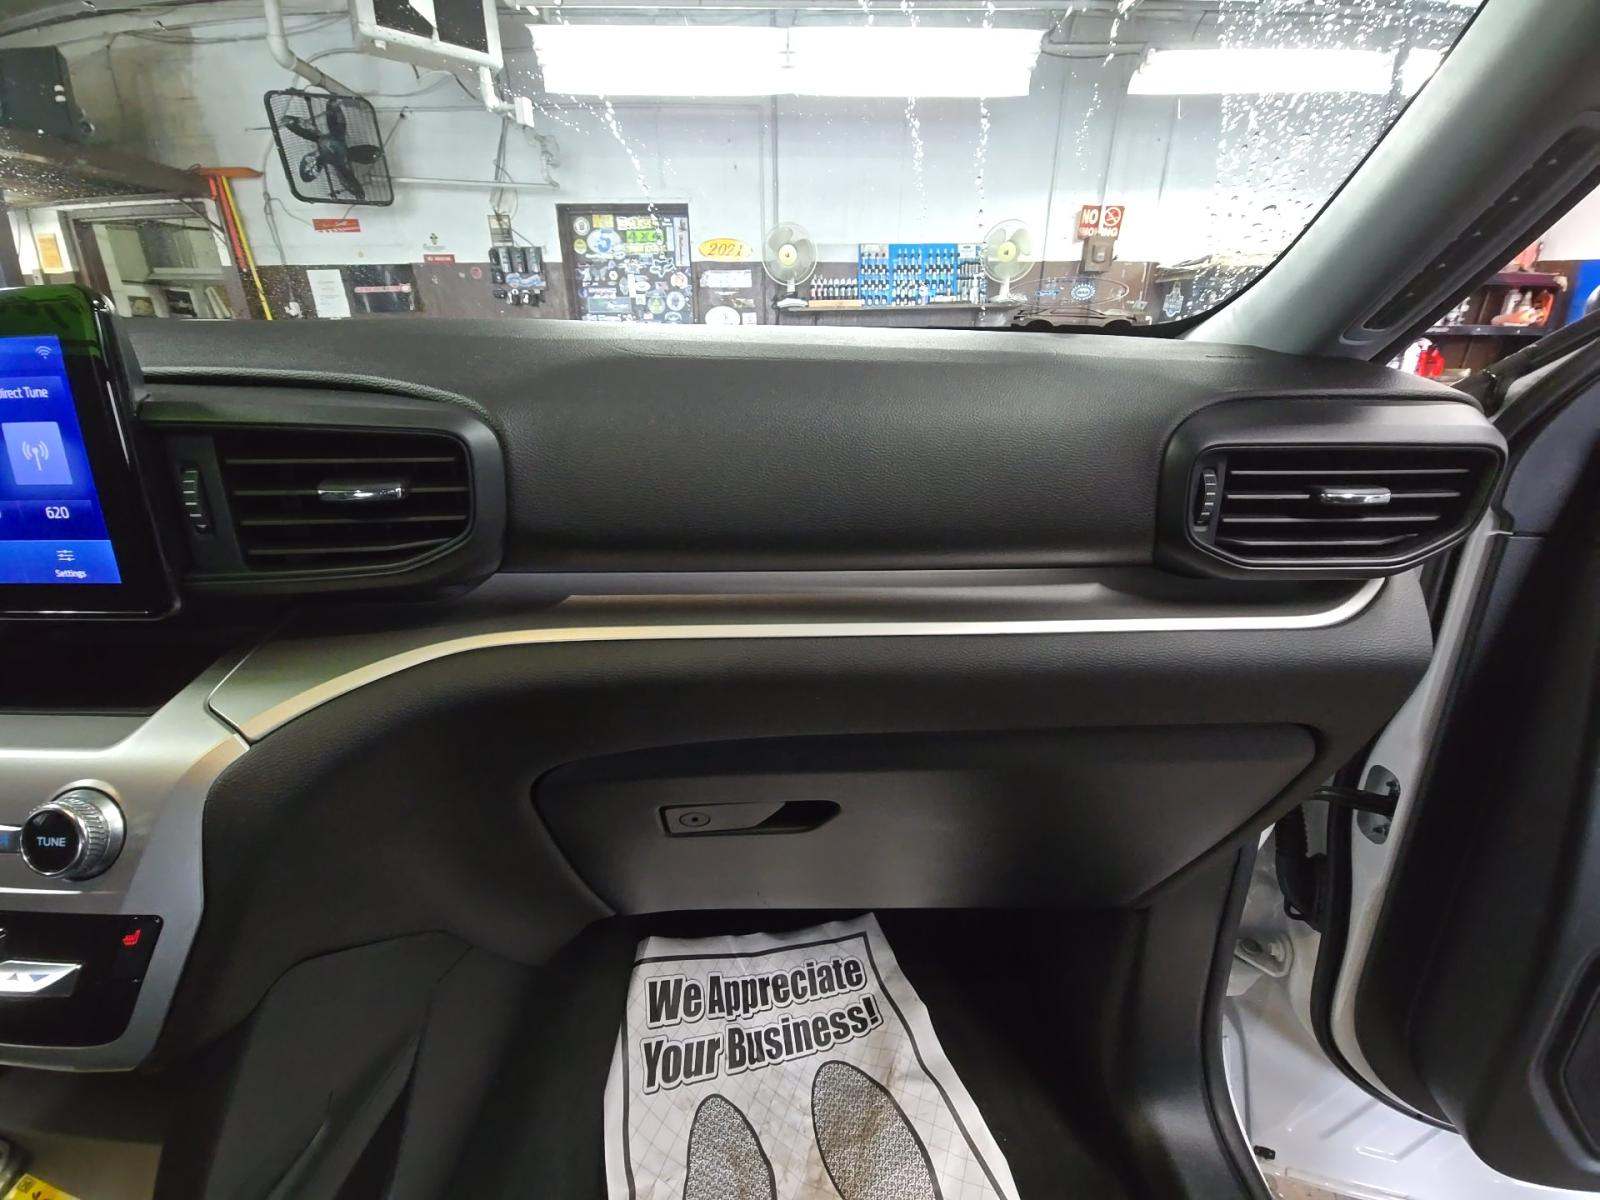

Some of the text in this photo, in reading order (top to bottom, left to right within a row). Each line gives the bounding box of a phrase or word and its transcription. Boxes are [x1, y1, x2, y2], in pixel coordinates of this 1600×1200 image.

[1081, 208, 1099, 224] NO
[23, 386, 49, 398] Tune
[45, 506, 70, 519] 620
[55, 568, 87, 579] Settings
[36, 836, 66, 847] TUNE
[646, 958, 865, 1024] We Appreciate
[641, 996, 880, 1090] Your Business!
